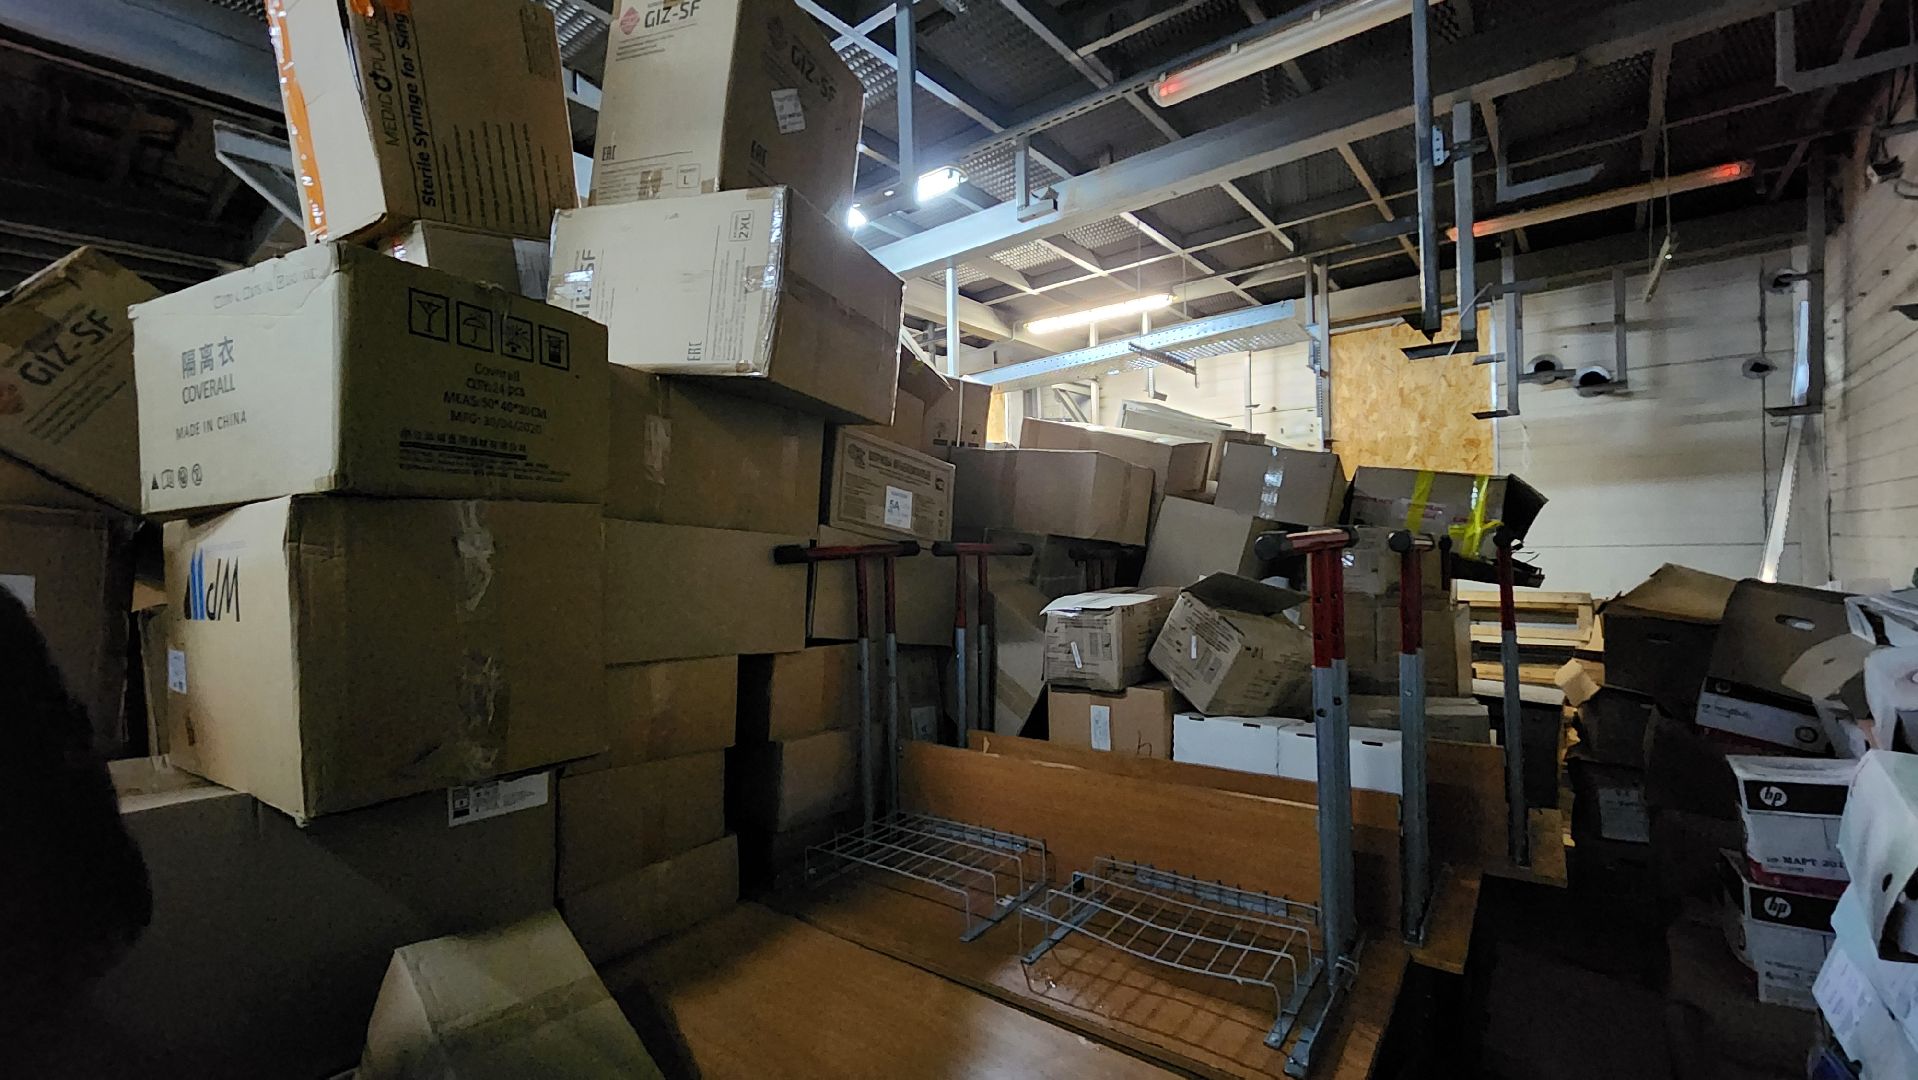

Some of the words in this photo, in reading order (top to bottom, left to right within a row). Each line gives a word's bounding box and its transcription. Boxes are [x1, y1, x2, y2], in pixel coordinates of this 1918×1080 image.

[644, 0, 702, 29] GIZ-SF
[401, 55, 415, 80] for
[791, 45, 838, 101] GIZ-SF
[408, 83, 430, 146] Syringe
[417, 150, 437, 207] Sterile
[738, 212, 752, 239] 2XL
[20, 309, 113, 386] GIZ-SF
[182, 373, 236, 405] COVERALL
[175, 421, 200, 441] MADE
[203, 418, 214, 433] IN
[216, 410, 247, 431] CHINA
[1763, 786, 1784, 807] hp
[1767, 895, 1788, 919] hp
